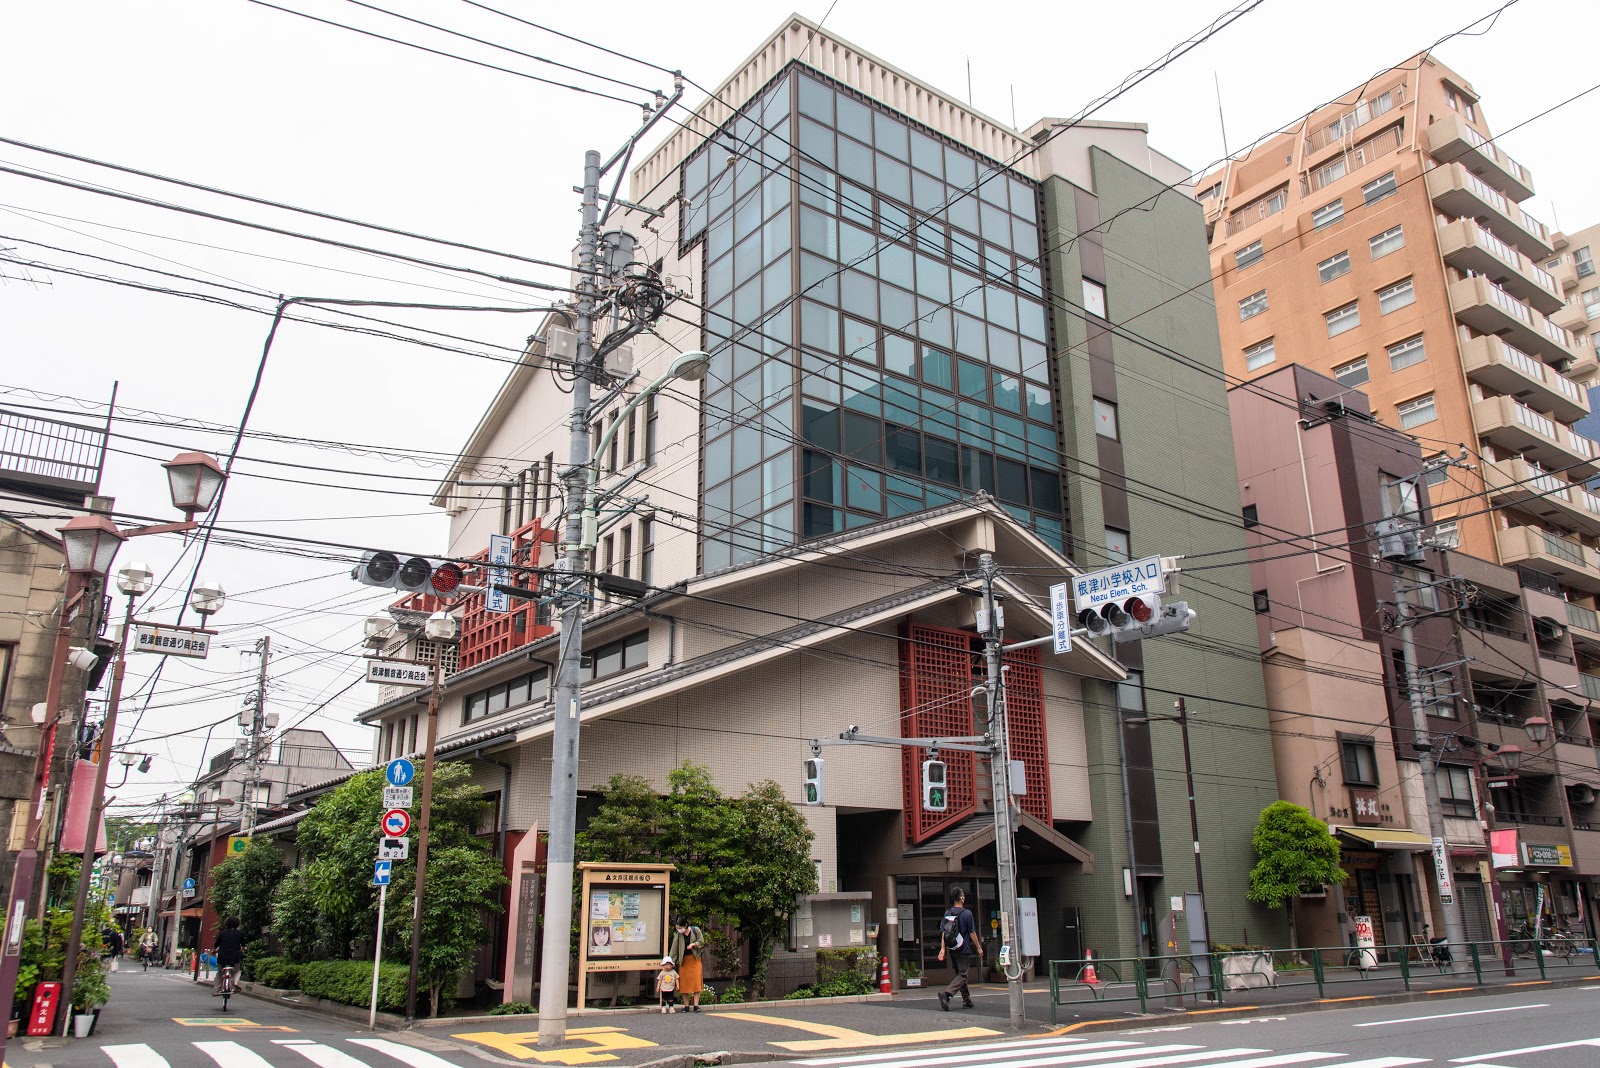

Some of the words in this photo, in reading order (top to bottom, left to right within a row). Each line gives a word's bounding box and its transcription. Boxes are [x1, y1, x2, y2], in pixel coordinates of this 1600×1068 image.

[1078, 563, 1157, 596] 根津小学校入口
[1090, 593, 1108, 603] Nezu
[1110, 588, 1130, 599] Elem.
[1131, 582, 1148, 593] Sch.
[140, 634, 206, 652] 根津観音通り商店会
[371, 666, 426, 681] 根津観音通り商店会
[1356, 797, 1379, 816] 丼丸
[38, 1000, 50, 1024] 消火器
